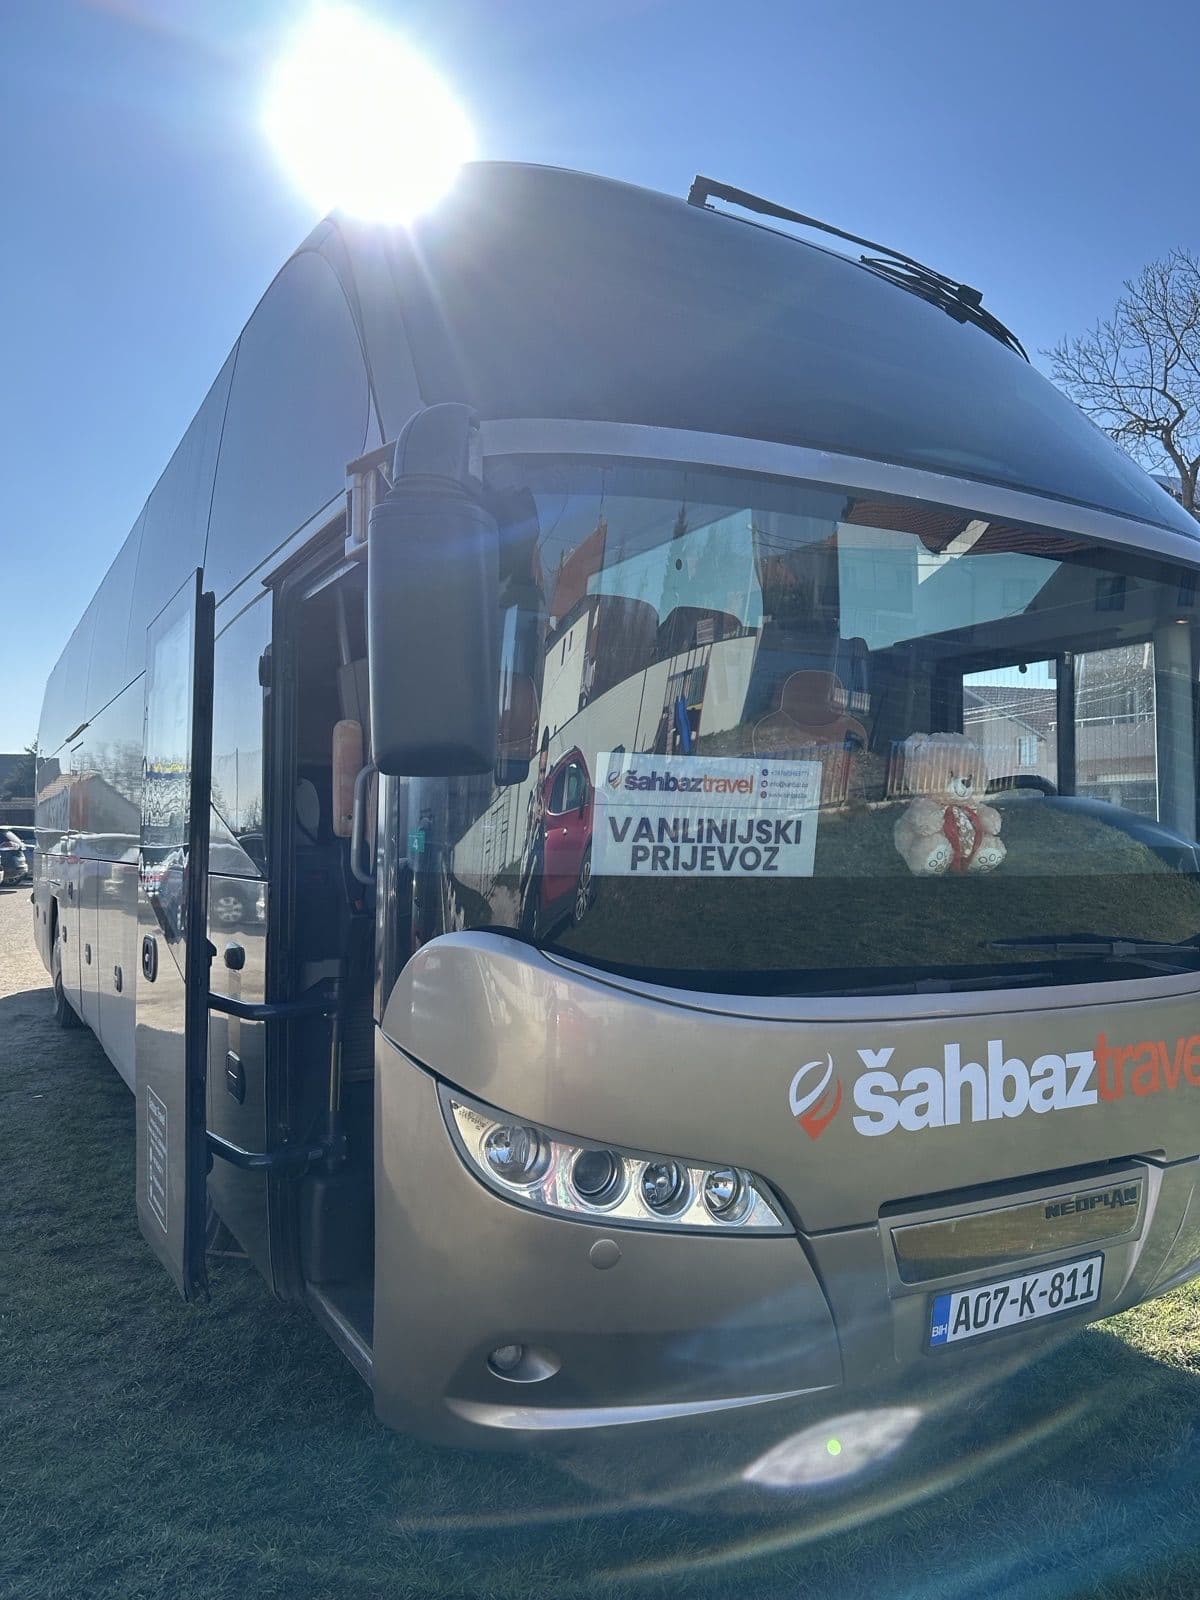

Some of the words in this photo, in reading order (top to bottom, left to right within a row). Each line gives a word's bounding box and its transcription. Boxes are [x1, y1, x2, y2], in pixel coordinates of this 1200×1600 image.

[608, 816, 803, 845] VANLINIJSKI
[630, 845, 780, 871] PRIJEVOZ
[851, 1033, 1200, 1138] šahbaztrave
[952, 1263, 1095, 1335] A07-K-811
[931, 1323, 949, 1338] BIH
